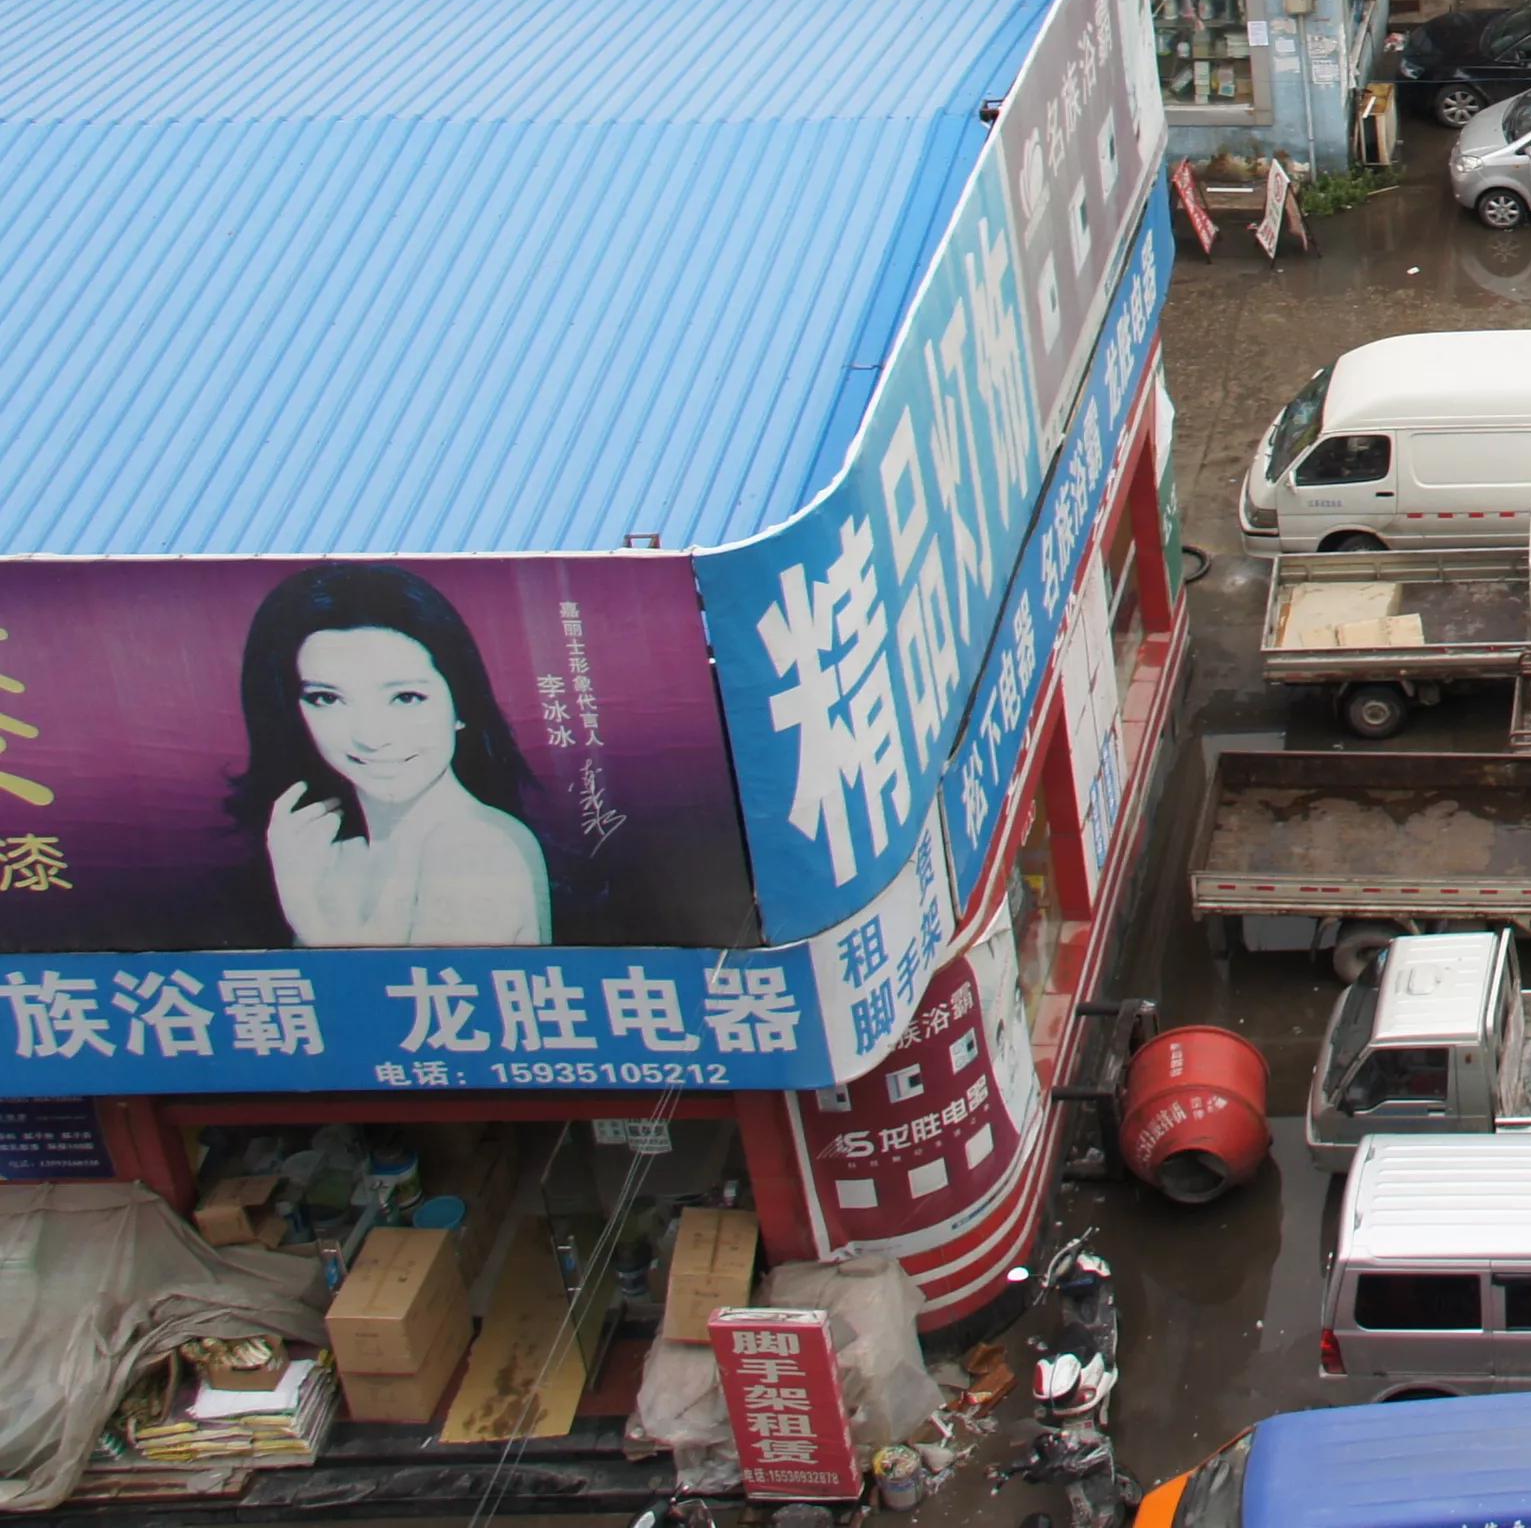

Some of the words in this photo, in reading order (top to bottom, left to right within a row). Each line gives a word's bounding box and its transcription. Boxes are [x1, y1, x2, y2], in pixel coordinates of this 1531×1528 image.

[755, 217, 1031, 888] 精品灯饰
[536, 673, 576, 749] 李冰冰
[558, 601, 605, 748] 嘉丽士形象代言人
[961, 588, 1036, 851] 松下电器
[4, 968, 326, 1059] 族浴霸
[386, 964, 801, 1055] 龙胜电器
[375, 1059, 470, 1089] 电话：
[489, 1061, 731, 1088] 15935105212
[731, 1330, 819, 1465] 脚手架租赁
